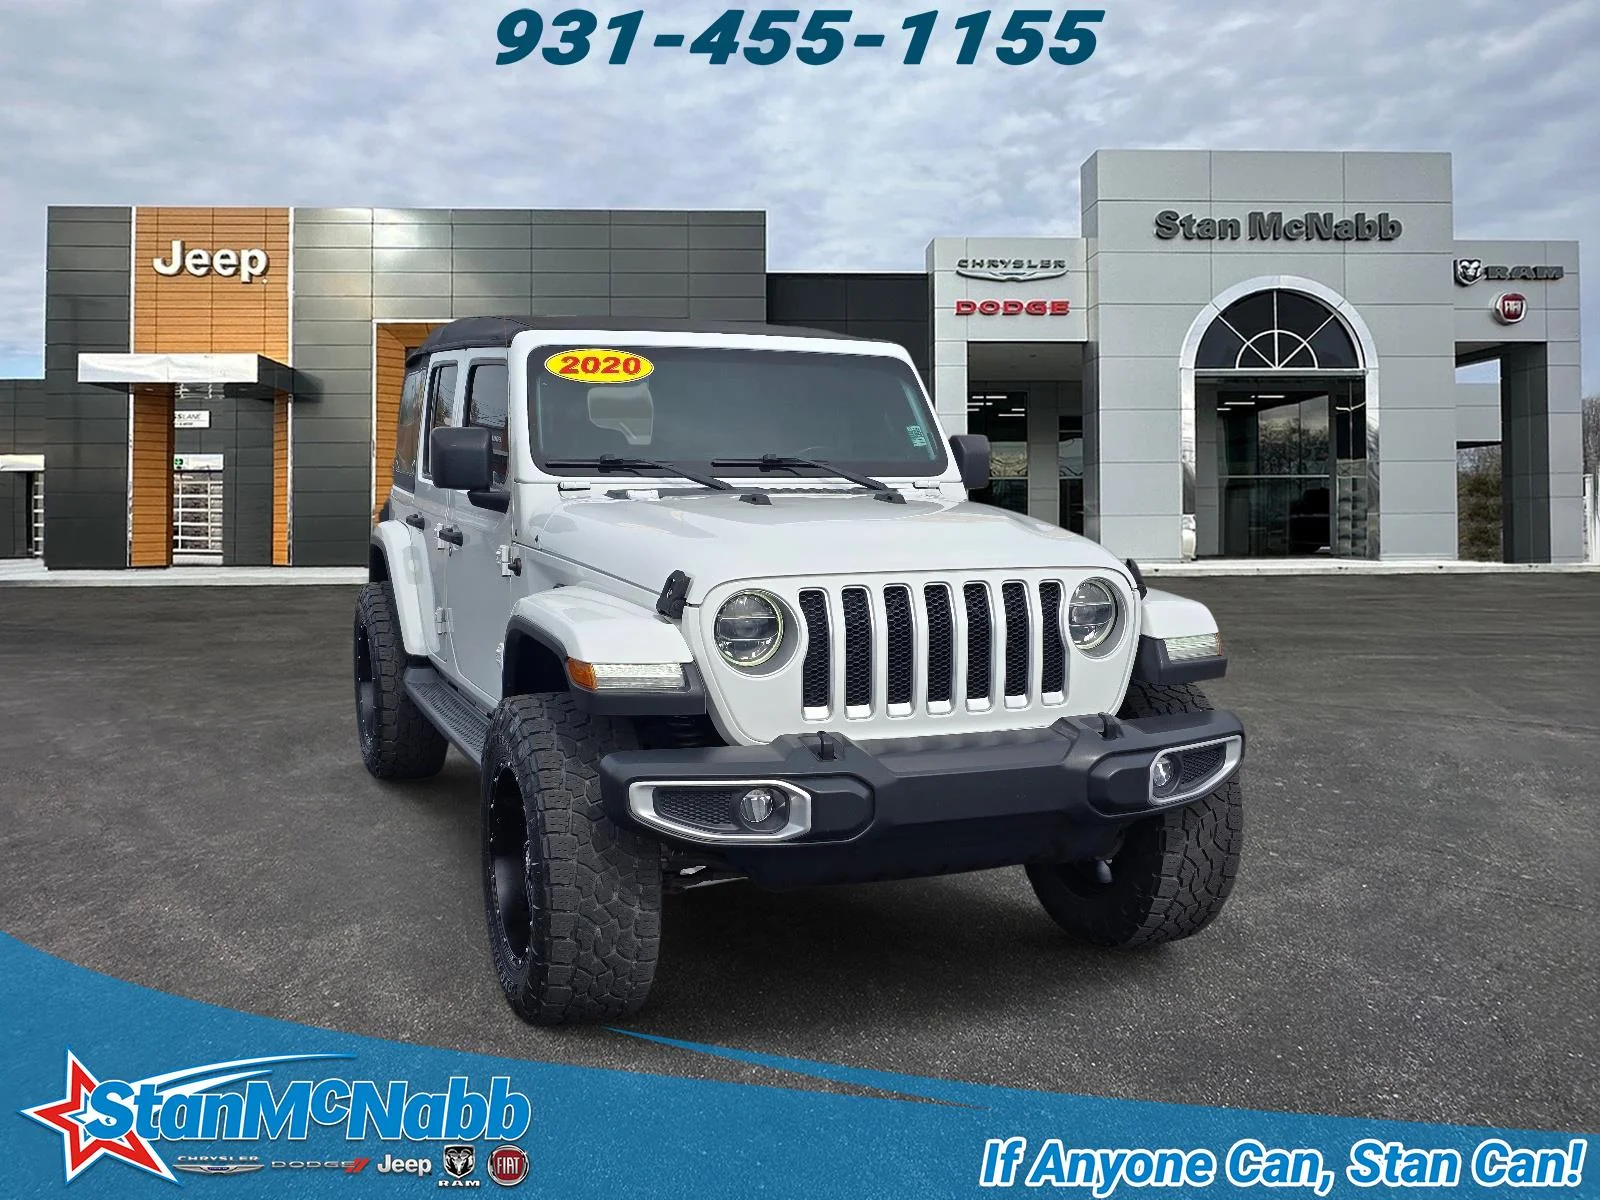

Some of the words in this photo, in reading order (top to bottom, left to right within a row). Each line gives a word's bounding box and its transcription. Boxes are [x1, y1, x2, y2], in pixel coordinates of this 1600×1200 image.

[1155, 210, 1241, 241] Stan
[1248, 211, 1403, 241] McNabb
[152, 240, 270, 284] Jeep
[957, 259, 1066, 269] CHRYSLER
[1485, 265, 1564, 280] RAM
[956, 300, 1070, 316] DODGE
[560, 356, 642, 375] 2020
